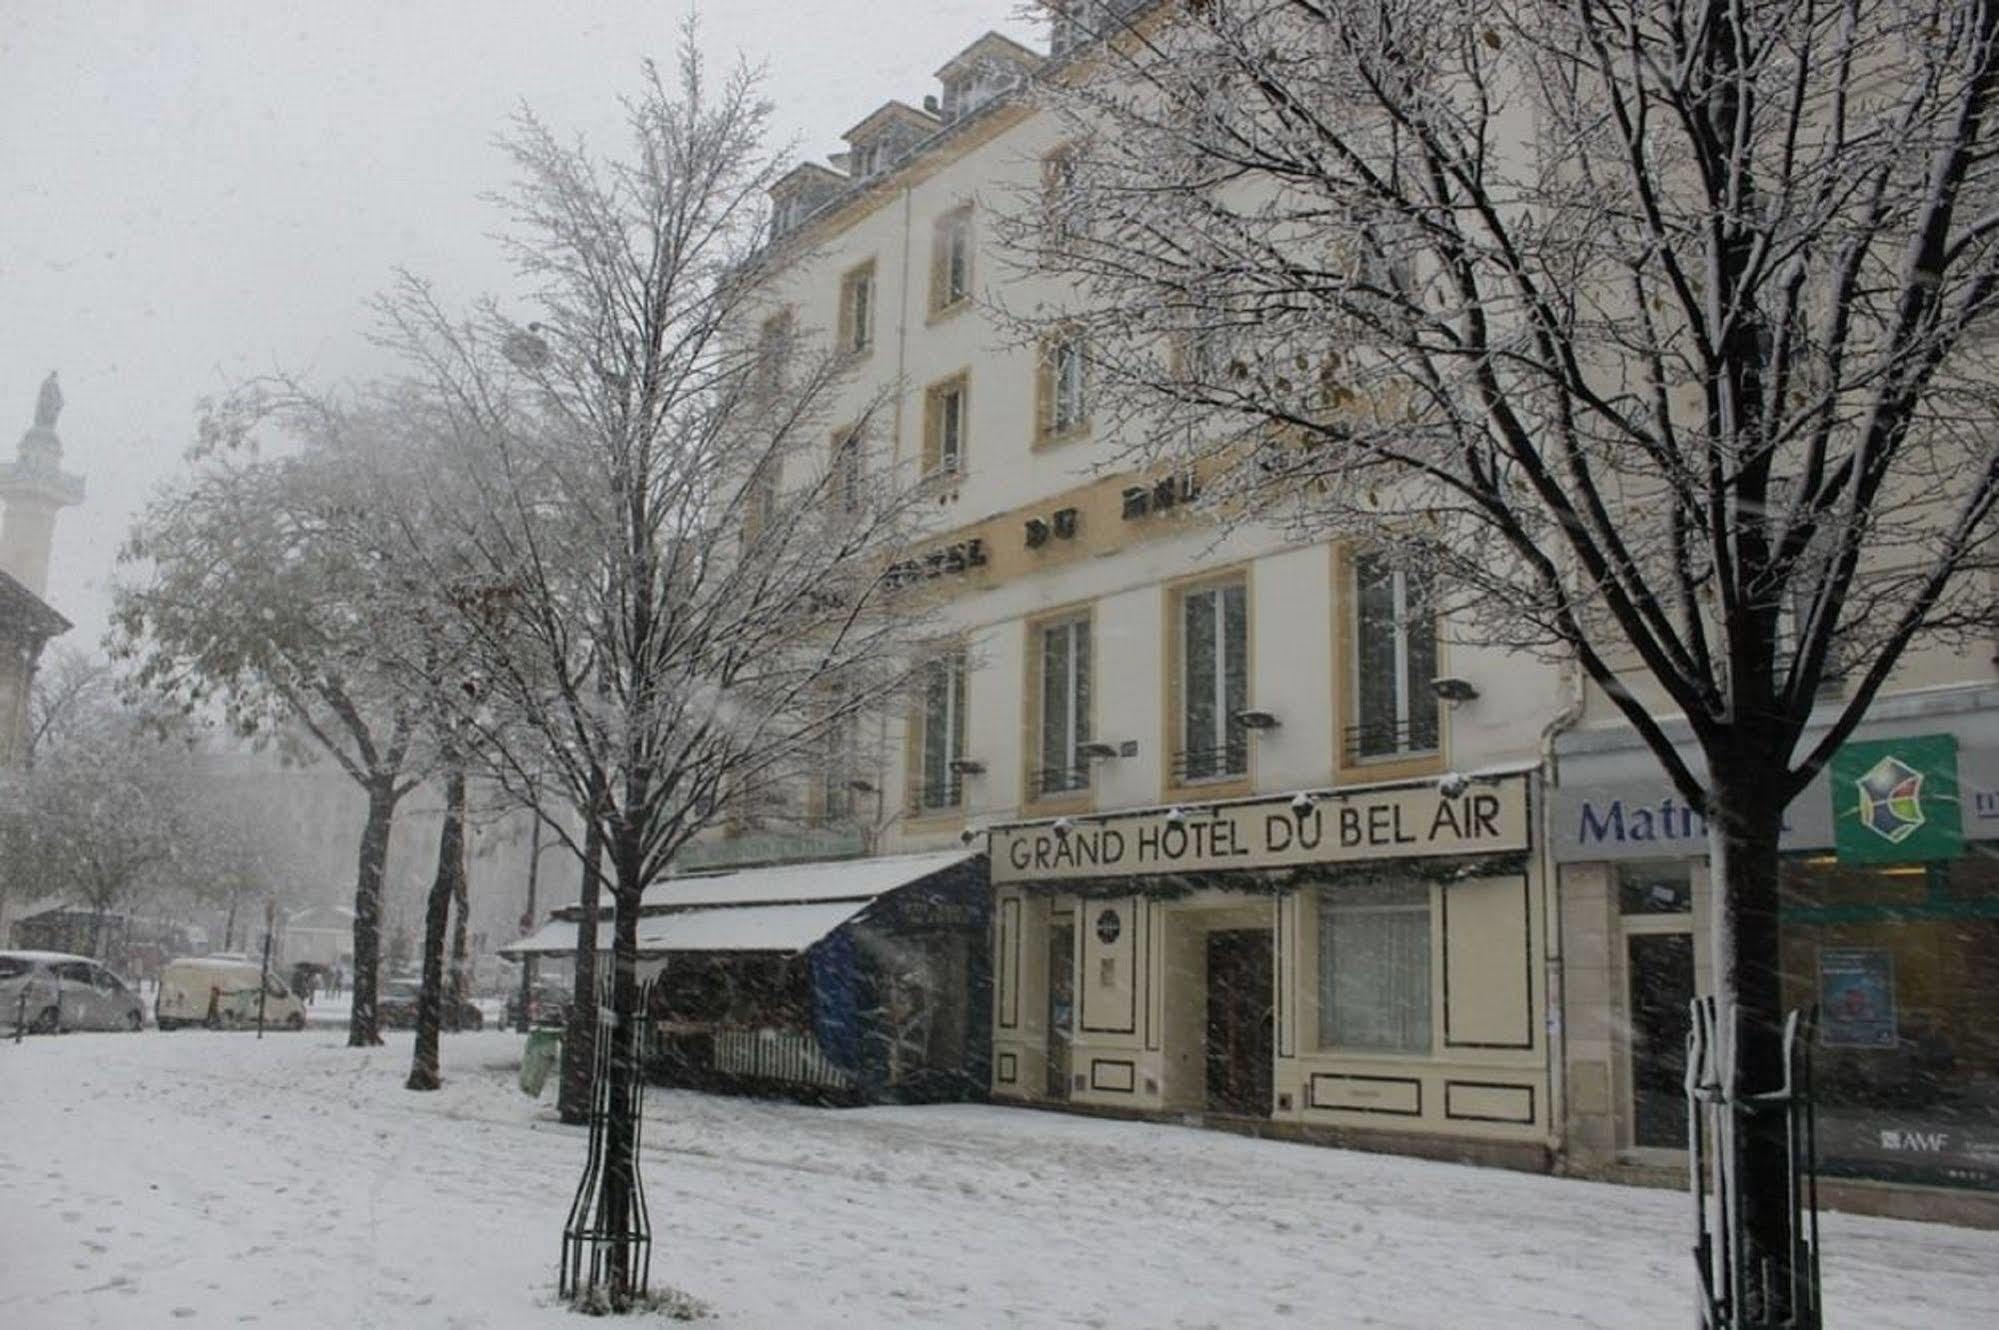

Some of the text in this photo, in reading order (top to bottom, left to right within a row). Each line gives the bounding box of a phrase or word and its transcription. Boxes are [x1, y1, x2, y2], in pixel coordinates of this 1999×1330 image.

[1009, 830, 1125, 870] GRAND
[1266, 808, 1321, 851] DU
[1340, 804, 1416, 847] BEL
[1428, 794, 1500, 841] AIR
